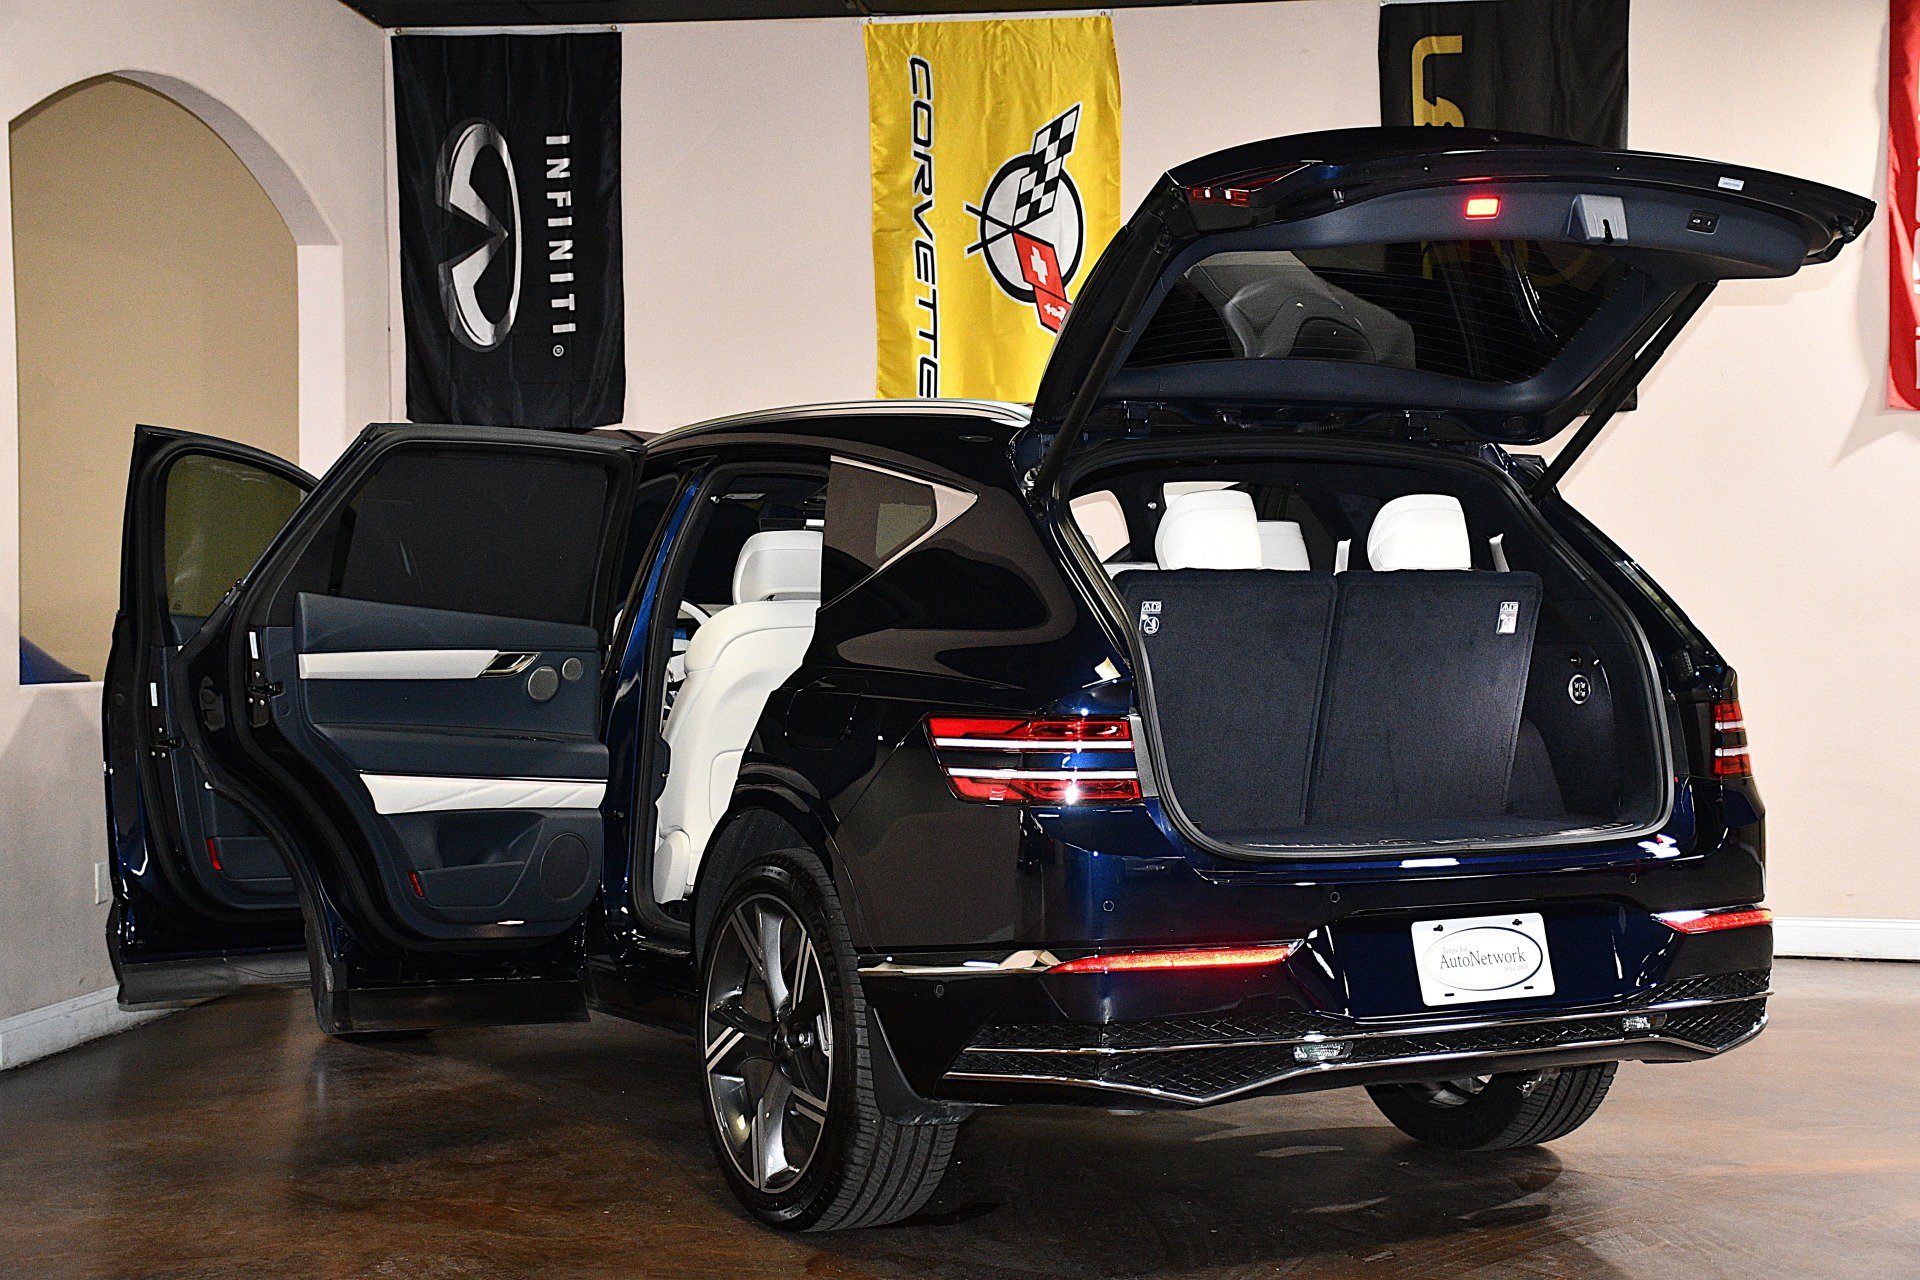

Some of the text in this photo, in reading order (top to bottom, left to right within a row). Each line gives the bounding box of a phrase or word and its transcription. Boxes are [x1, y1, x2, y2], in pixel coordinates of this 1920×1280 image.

[546, 135, 576, 333] INFINITI
[908, 55, 938, 398] CORVETTE
[1440, 947, 1526, 969] AutoNetwork
